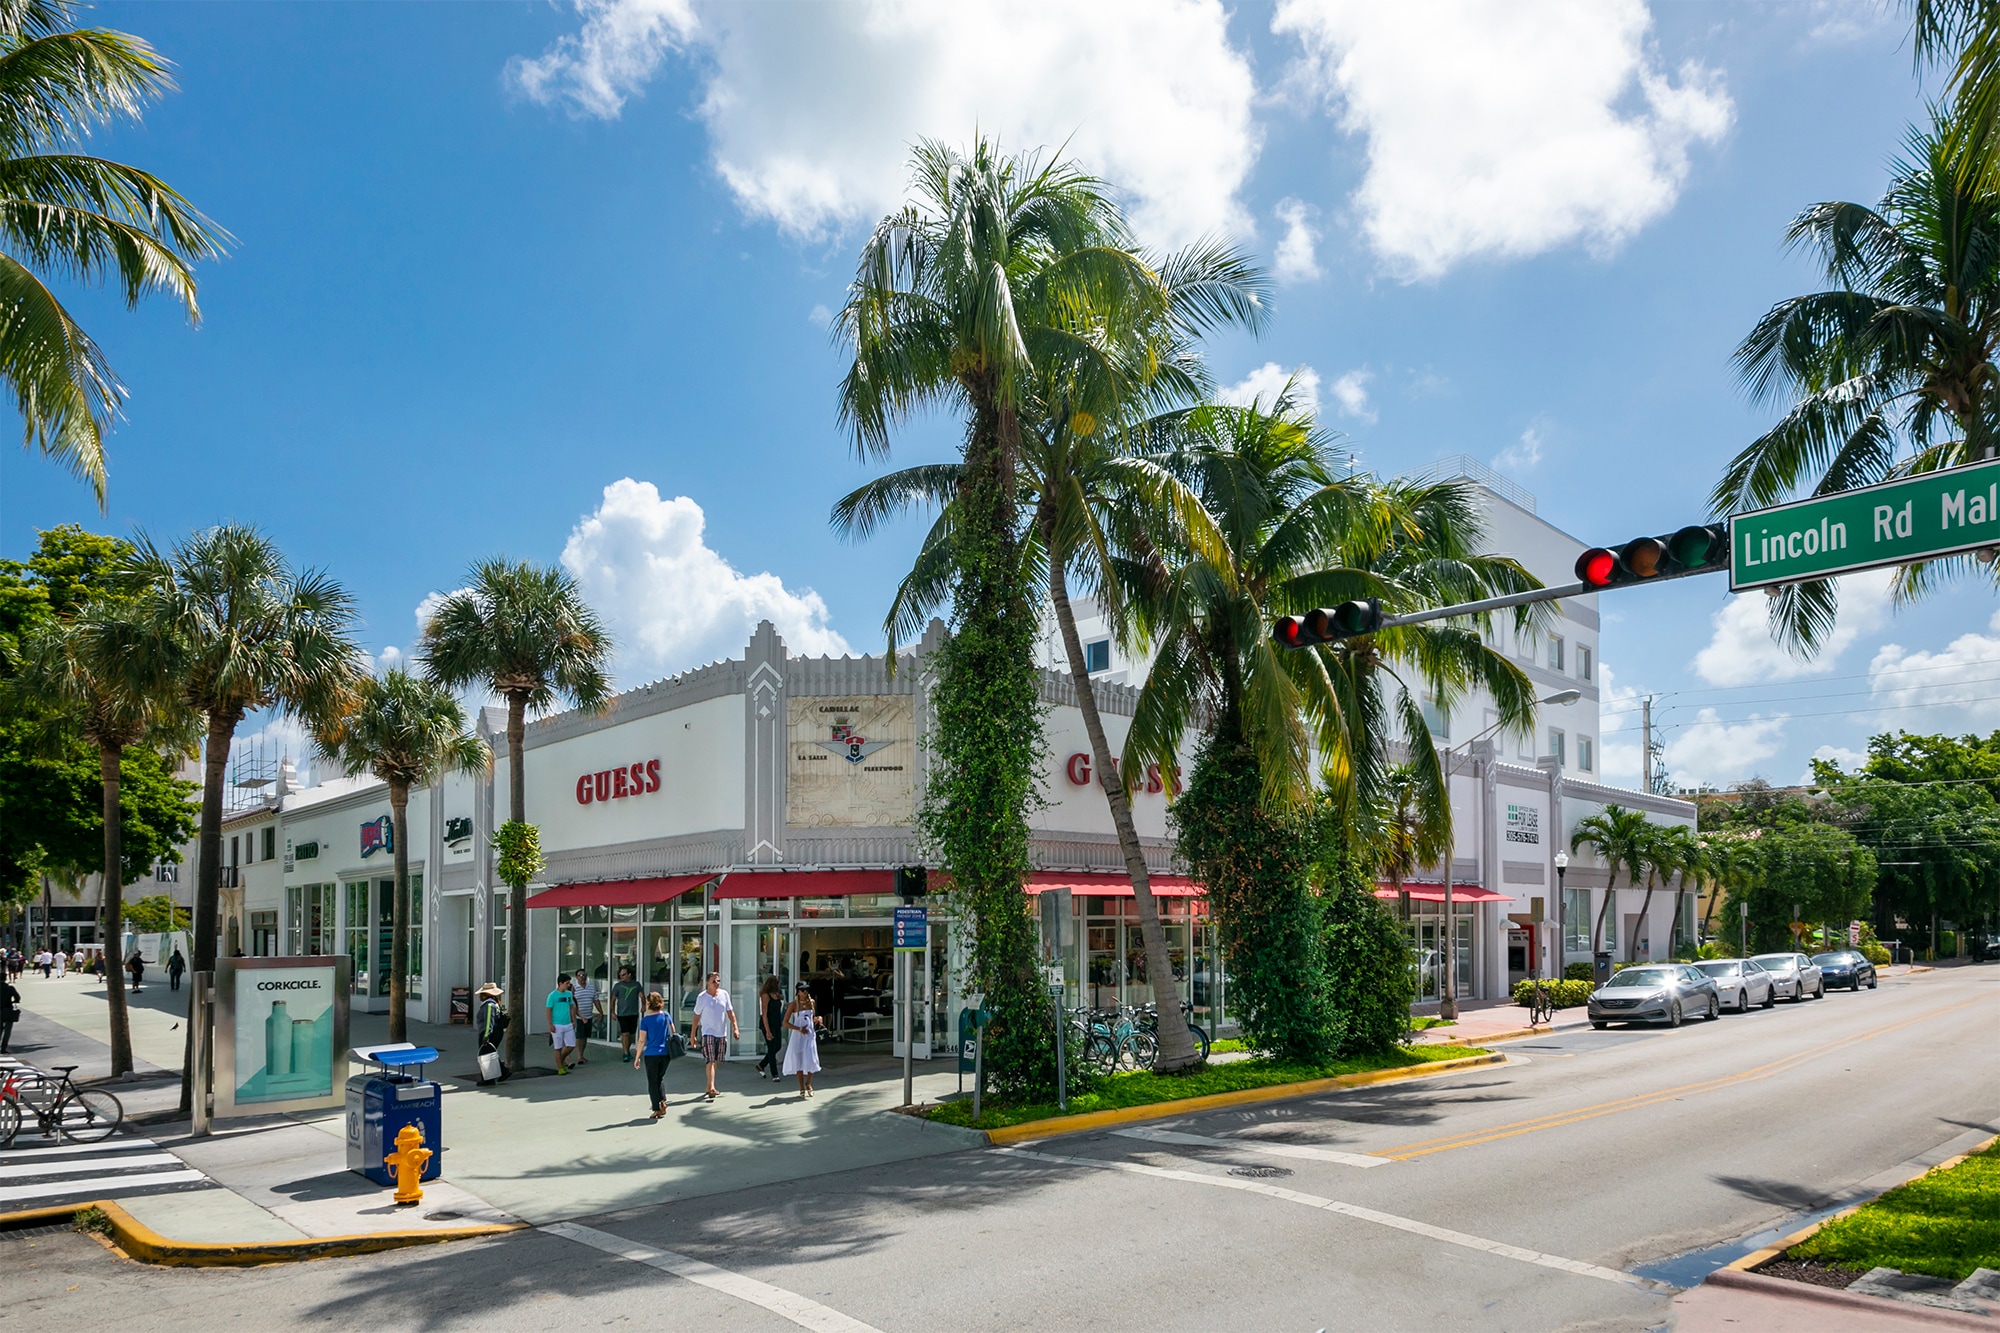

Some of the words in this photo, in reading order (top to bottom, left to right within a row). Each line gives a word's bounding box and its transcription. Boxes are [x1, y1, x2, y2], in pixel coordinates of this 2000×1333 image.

[1745, 517, 1847, 567] Lincoln
[1874, 500, 1913, 542] Rd
[819, 705, 860, 713] CADILLAC
[576, 758, 660, 805] GUESS
[257, 980, 321, 991] CORKCICLE.
